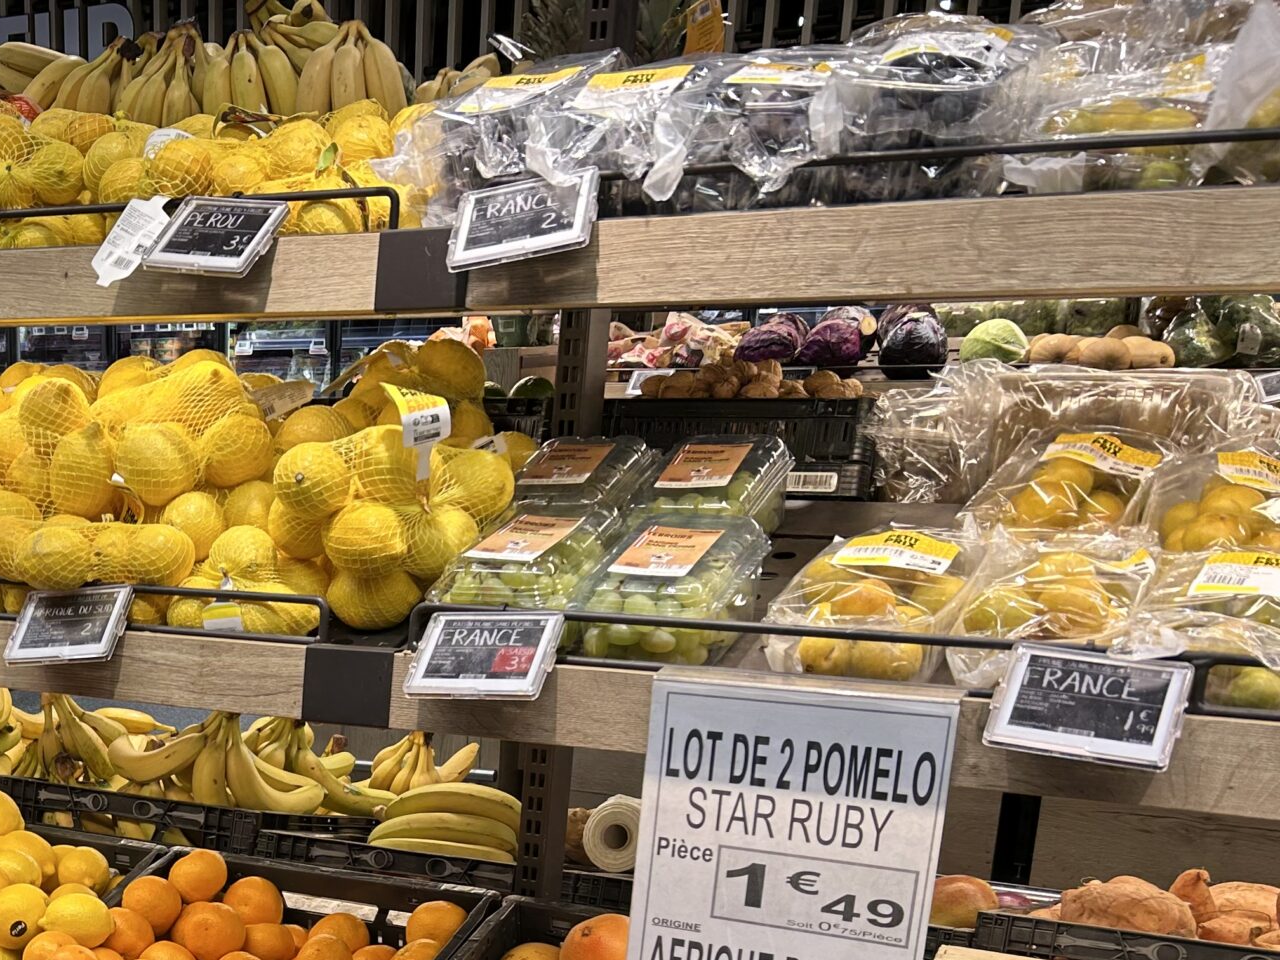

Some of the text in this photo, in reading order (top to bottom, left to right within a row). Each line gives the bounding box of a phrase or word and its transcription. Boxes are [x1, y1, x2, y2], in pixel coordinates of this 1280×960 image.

[183, 212, 245, 229] PEROU
[541, 213, 557, 228] 2
[223, 236, 239, 250] 3
[33, 603, 113, 617] AFRIQUE DU SUD
[81, 622, 92, 635] 2
[437, 628, 525, 647] FRANCE
[505, 656, 519, 670] 3
[1023, 667, 1140, 702] FRANCE
[1124, 710, 1133, 731] 1
[665, 728, 936, 807] LOT DE 2 POMELO
[686, 786, 894, 851] STAR RUBY
[657, 836, 714, 863] Pièce
[726, 863, 904, 928] 1 € 49
[651, 916, 702, 932] ORIGINE
[786, 919, 813, 930] Soit
